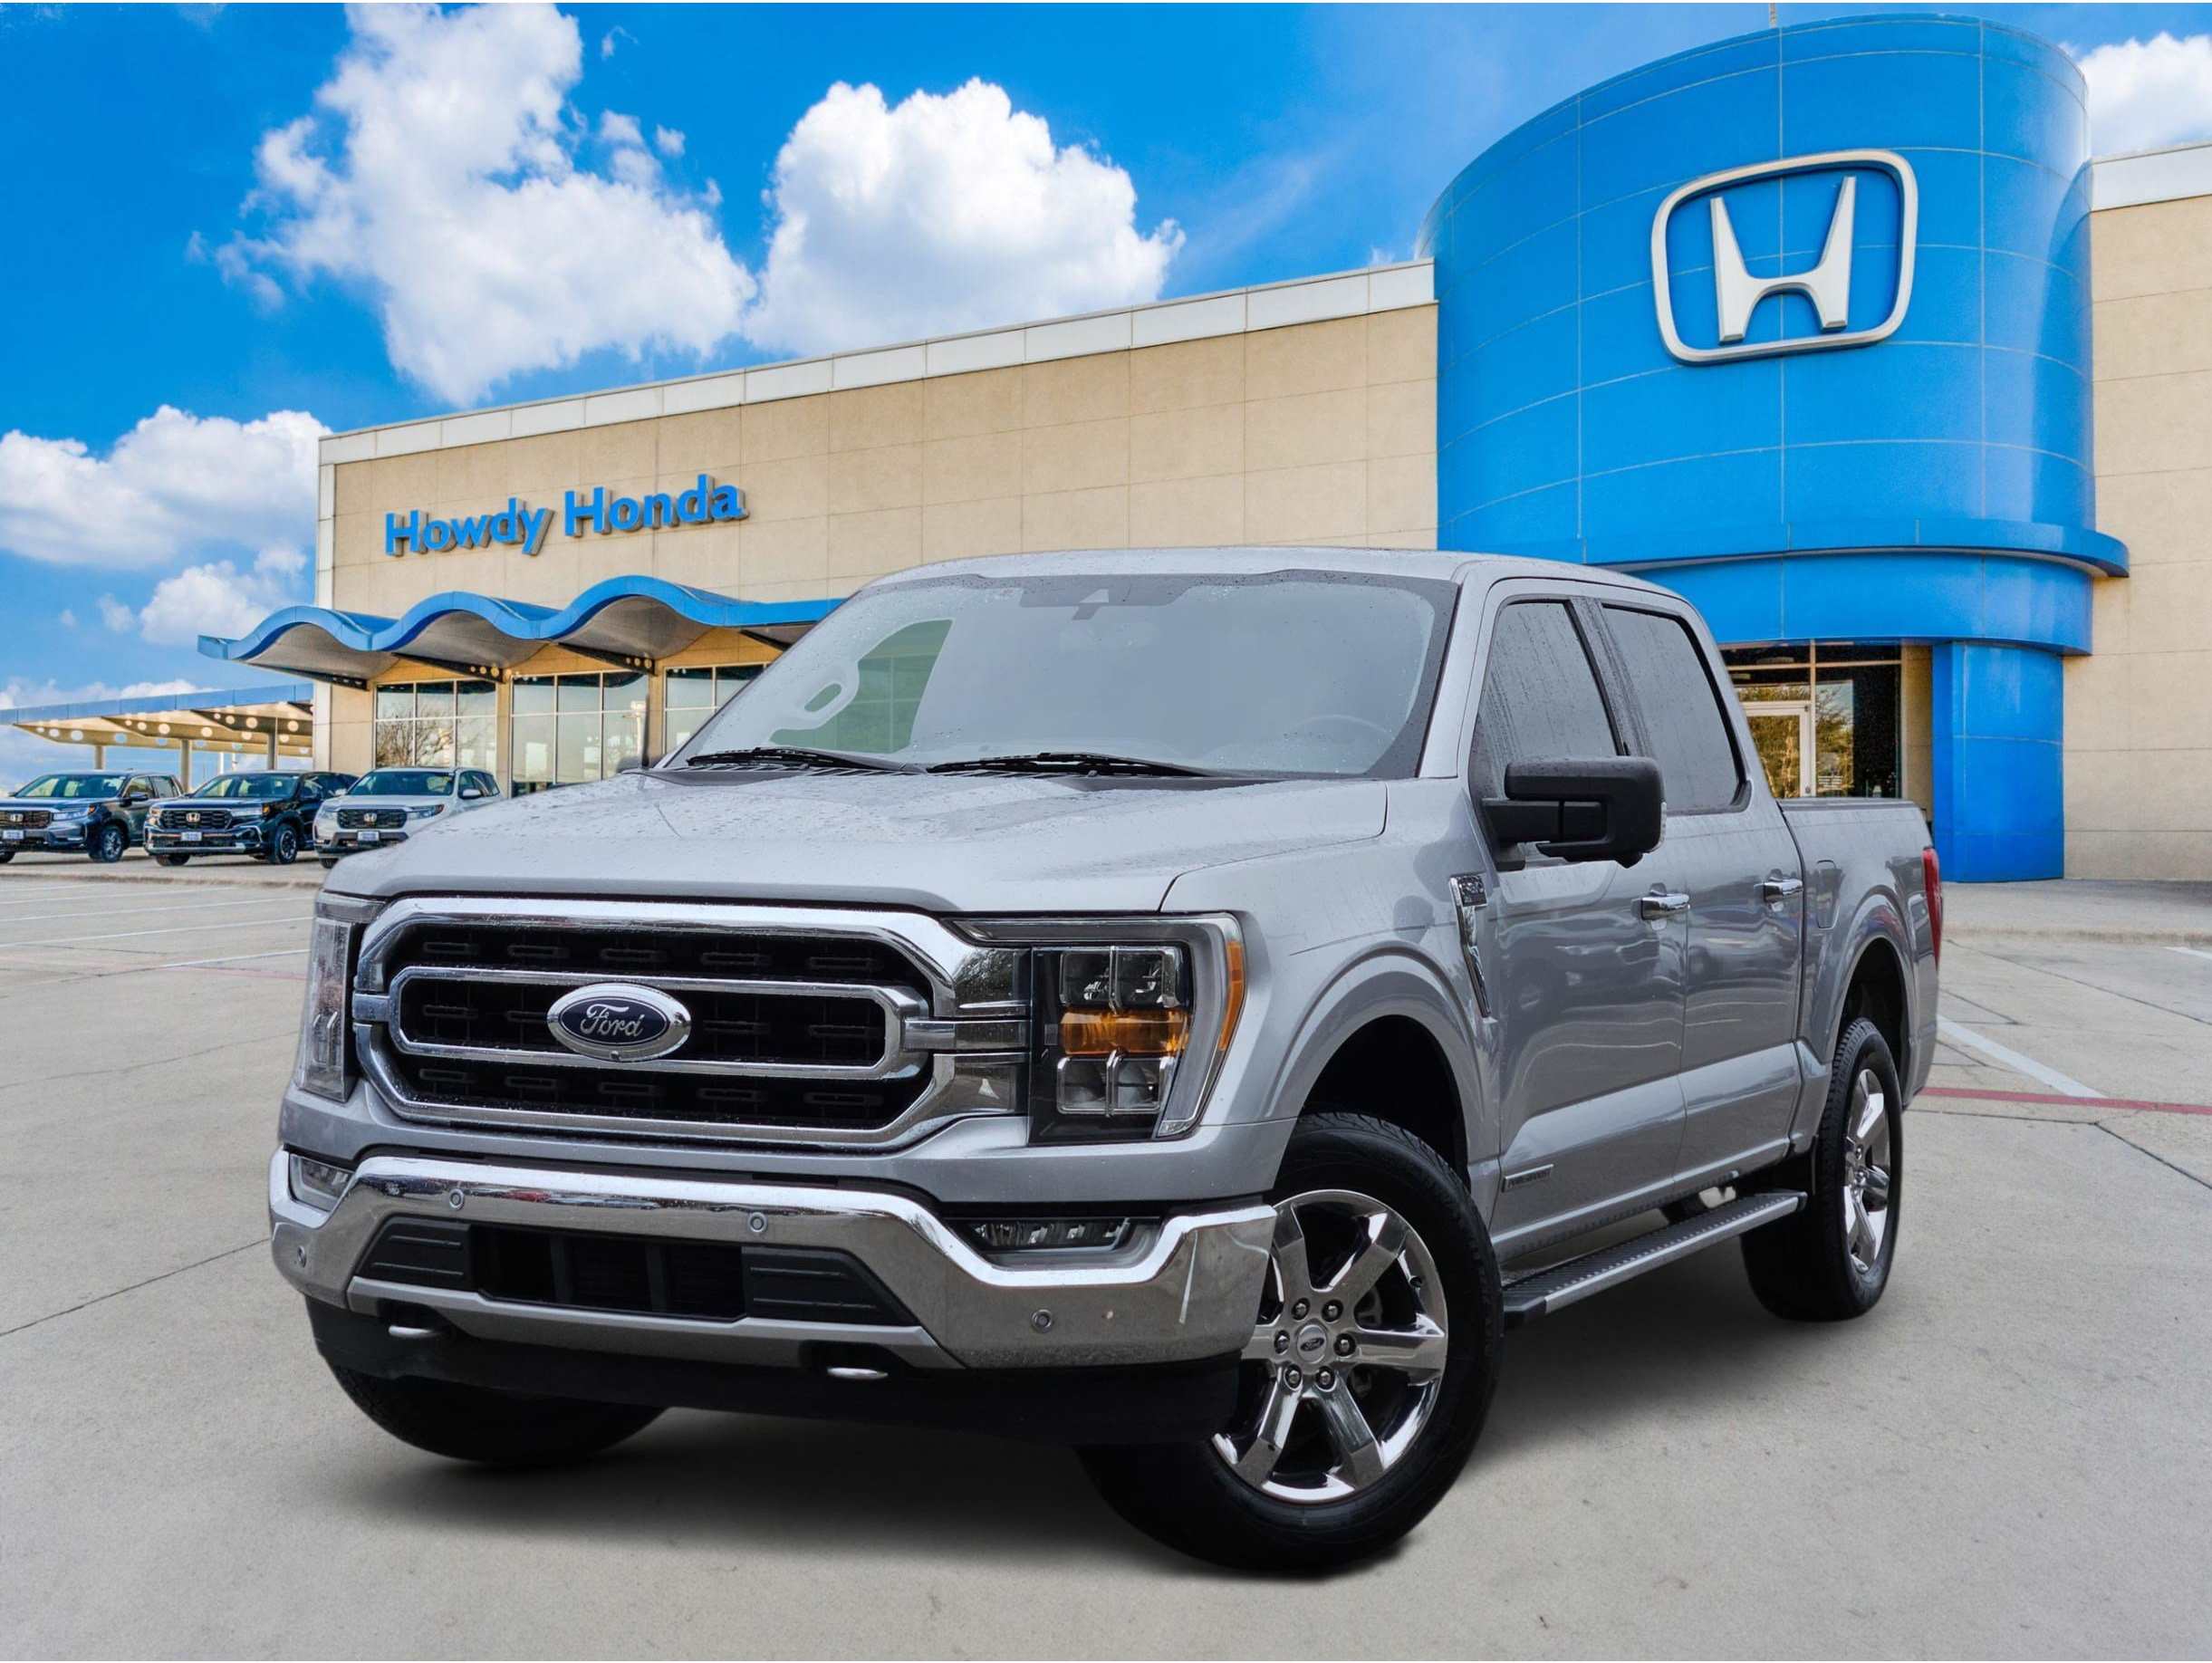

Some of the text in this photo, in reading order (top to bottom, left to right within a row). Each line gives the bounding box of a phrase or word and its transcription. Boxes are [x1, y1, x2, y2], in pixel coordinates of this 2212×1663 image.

[385, 474, 749, 557] Howdy Honda
[580, 1004, 646, 1036] Ford
